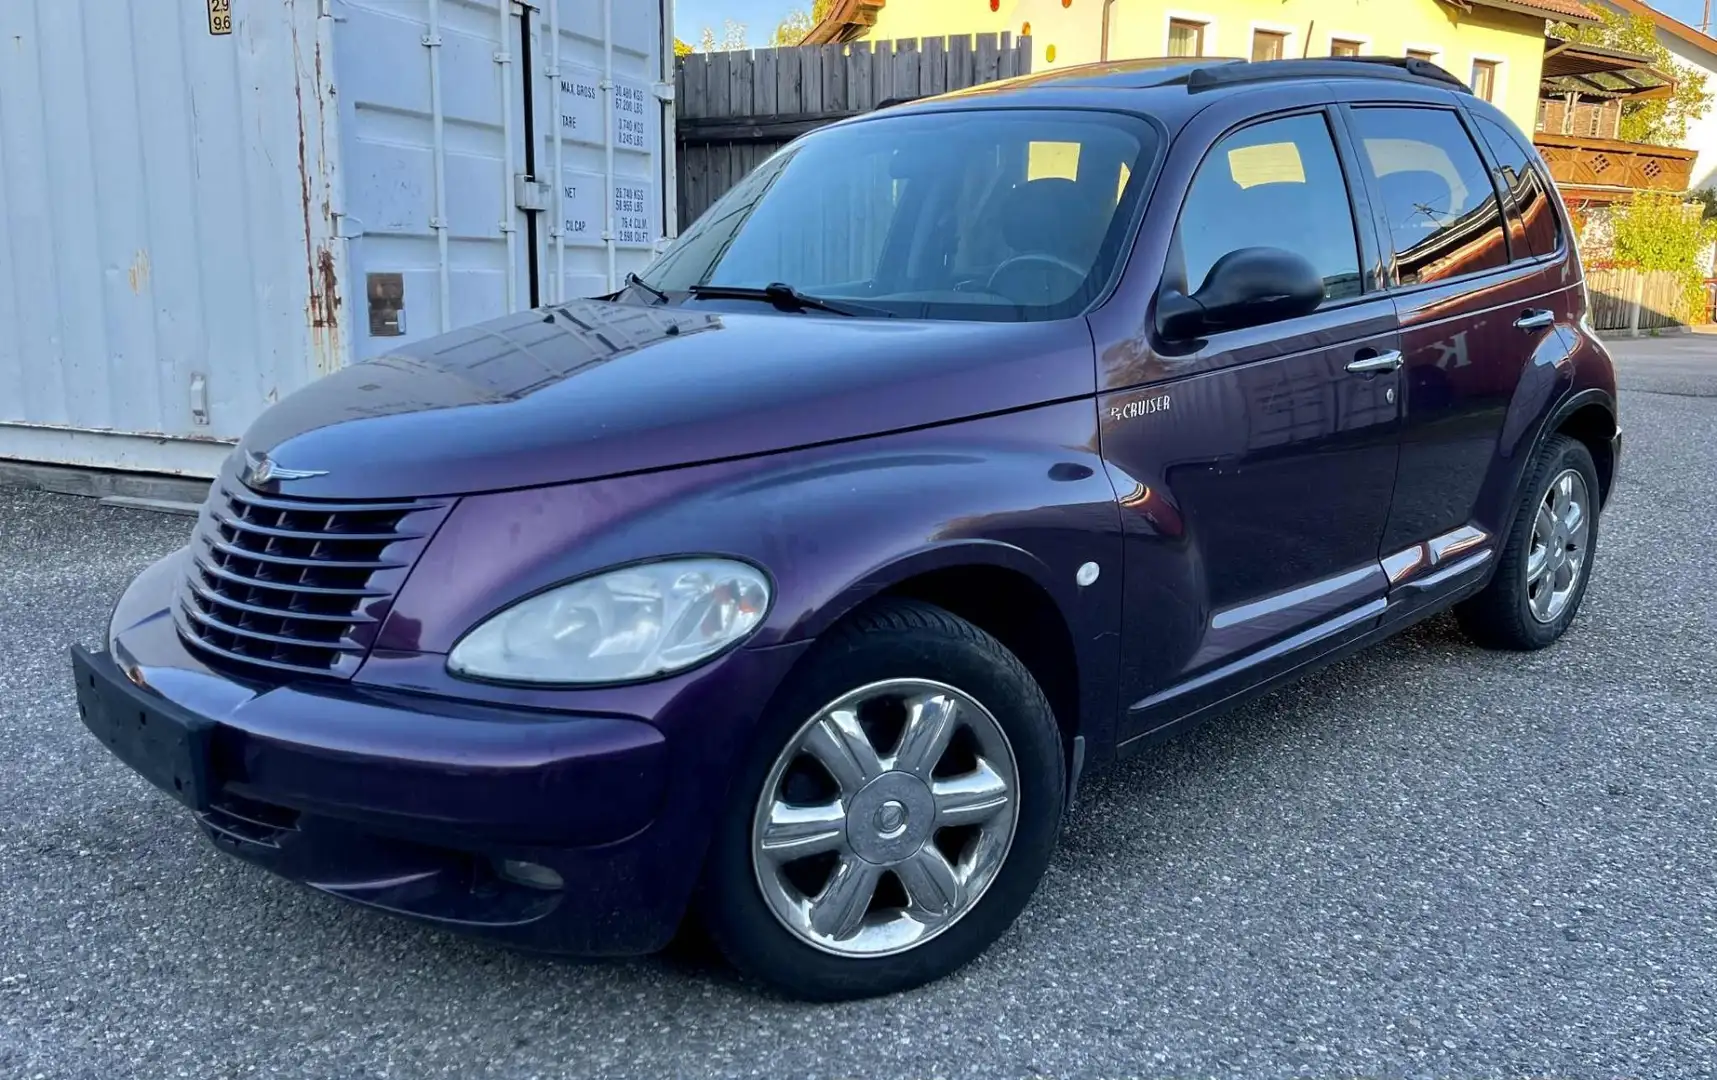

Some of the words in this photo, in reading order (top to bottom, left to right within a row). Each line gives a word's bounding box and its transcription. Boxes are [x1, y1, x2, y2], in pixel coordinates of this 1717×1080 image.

[562, 115, 577, 129] TARE
[564, 186, 576, 199] NET
[1122, 395, 1171, 419] CRUISER
